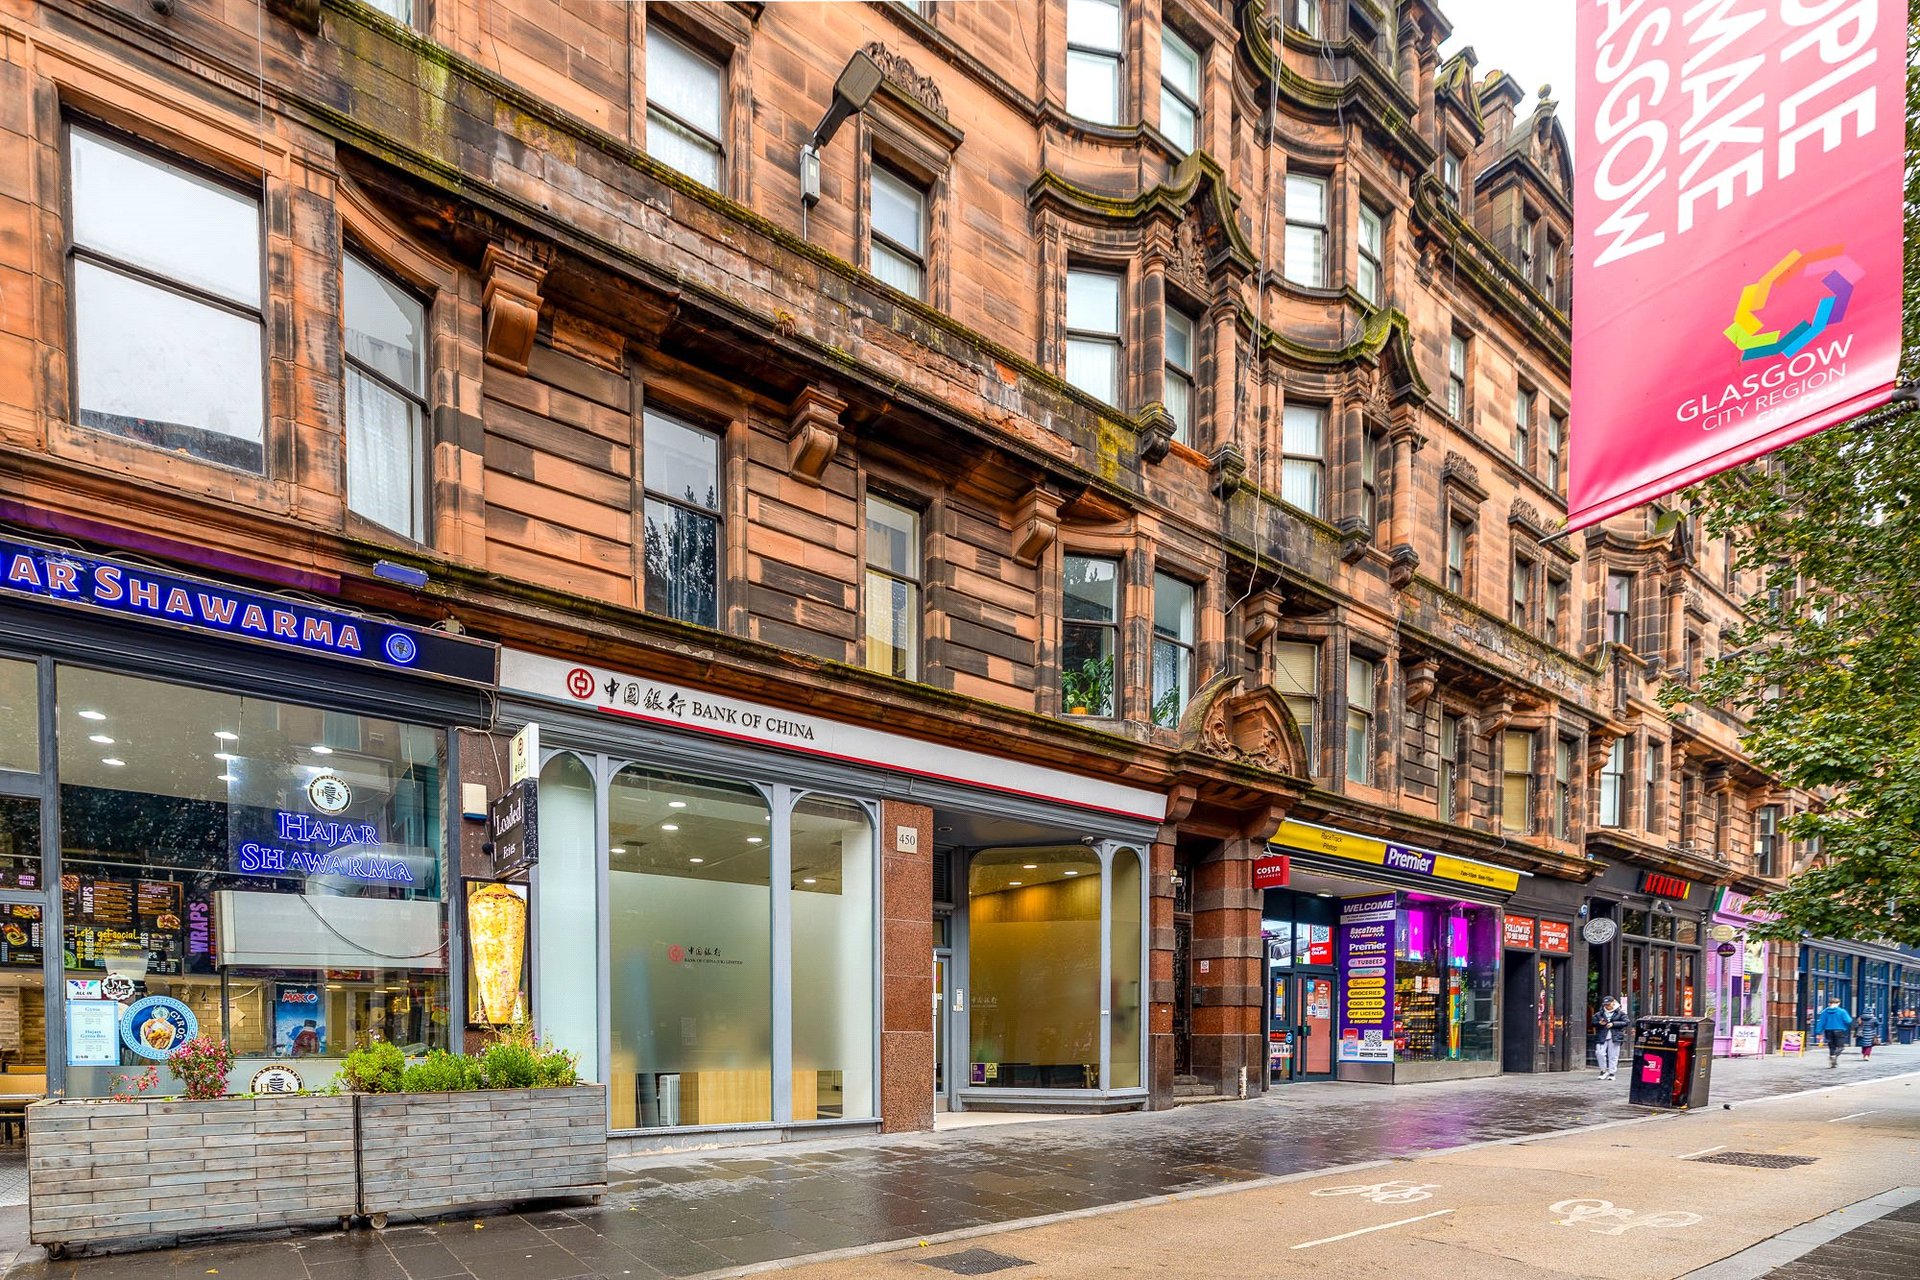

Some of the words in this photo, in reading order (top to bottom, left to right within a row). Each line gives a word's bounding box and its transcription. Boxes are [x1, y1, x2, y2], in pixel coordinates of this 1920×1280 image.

[1778, 0, 1879, 180] PLE
[1675, 333, 1854, 423] GLASGOW
[1702, 401, 1750, 431] CITY
[1756, 363, 1847, 411] REGION
[8, 553, 80, 593] AR
[93, 565, 362, 652] SHAWARMA
[691, 701, 738, 725] BANK
[741, 711, 762, 729] OF
[765, 717, 815, 741] CHINA
[278, 811, 381, 848] HAJAR
[495, 797, 523, 837] Loaded
[502, 842, 516, 860] Fries
[898, 833, 917, 846] 450
[241, 843, 414, 882] SHAWARMA
[1256, 865, 1281, 875] COSTA
[1386, 847, 1433, 873] Premier
[82, 886, 95, 913] WRAPS
[1343, 900, 1395, 914] WELCOME
[189, 902, 209, 953] WRAPS
[1505, 923, 1523, 934] FOLLOW
[1523, 926, 1531, 935] US
[1349, 942, 1387, 952] Premier
